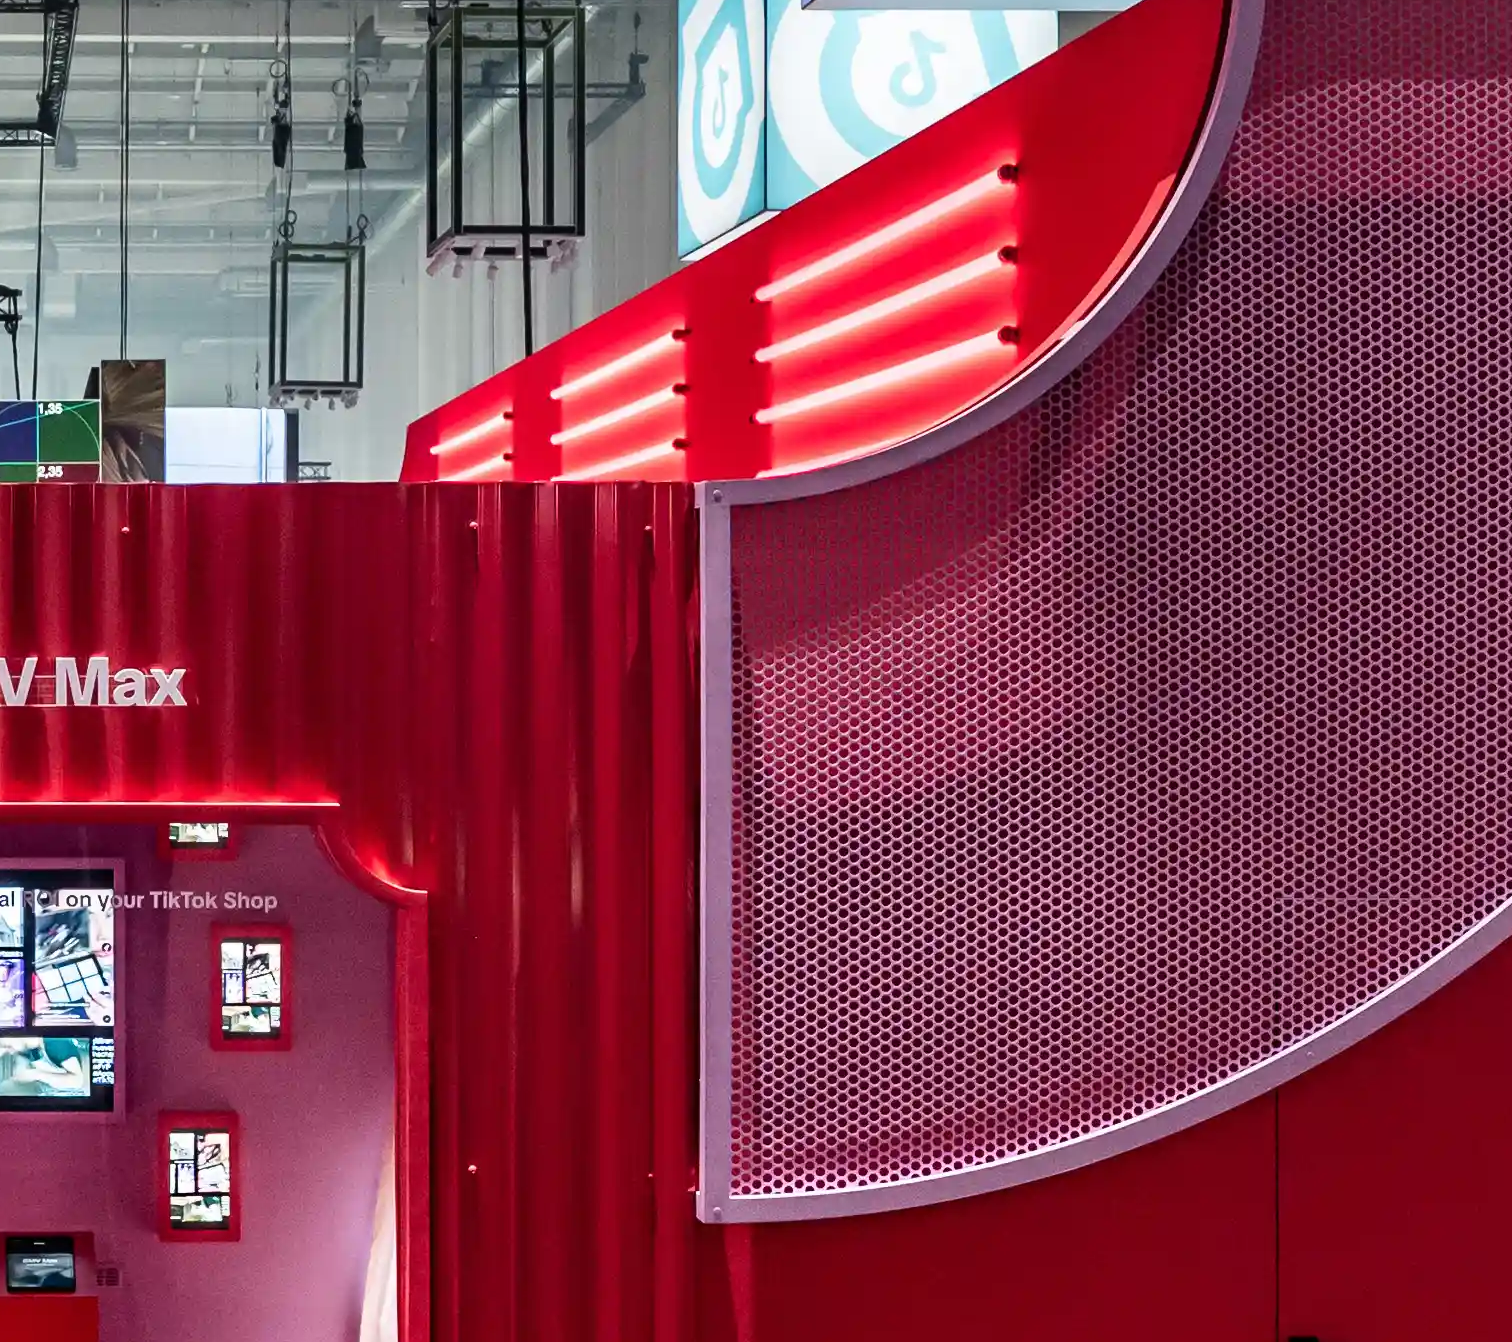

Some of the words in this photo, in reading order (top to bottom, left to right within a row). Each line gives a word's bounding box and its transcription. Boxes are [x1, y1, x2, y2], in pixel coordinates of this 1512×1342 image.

[38, 403, 63, 418] 1,35
[37, 466, 63, 480] 2,35
[55, 656, 187, 707] Max
[66, 893, 92, 909] on
[97, 893, 144, 913] your
[149, 890, 218, 909] TikTok
[223, 890, 278, 913] Shop
